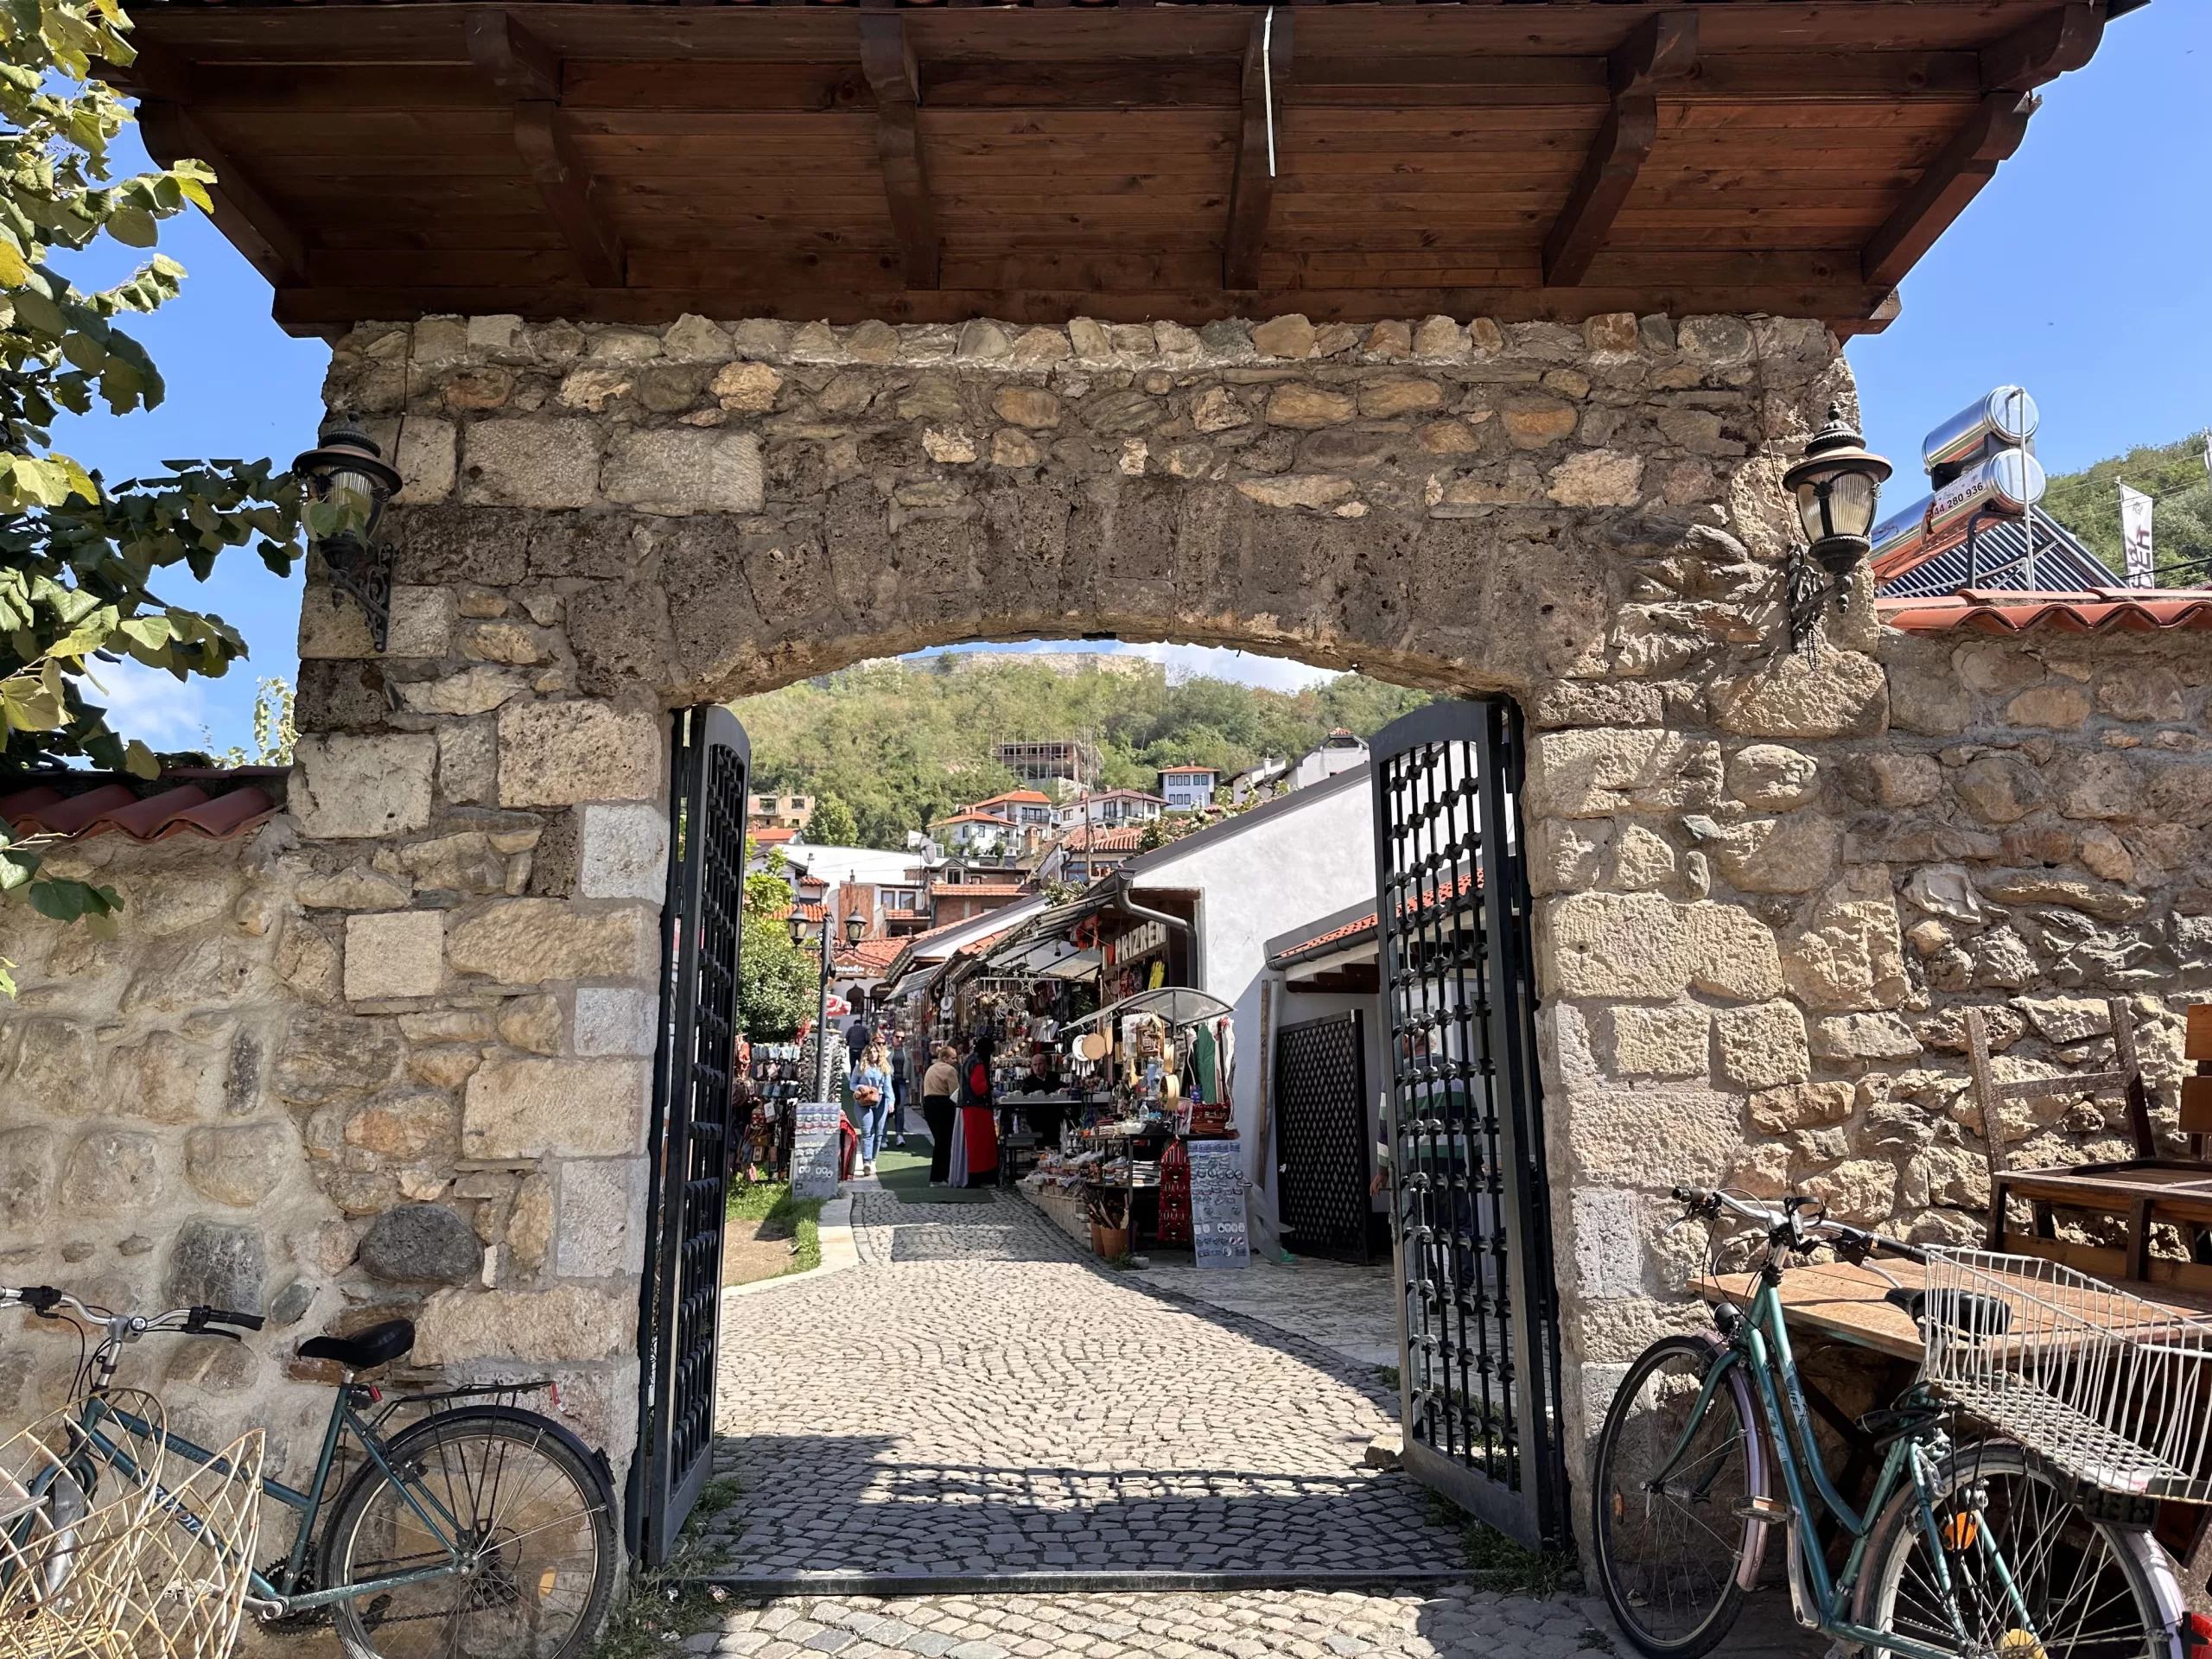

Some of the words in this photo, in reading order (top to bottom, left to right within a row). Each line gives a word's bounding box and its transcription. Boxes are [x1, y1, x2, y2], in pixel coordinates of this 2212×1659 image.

[1947, 493, 1964, 509] 280
[1966, 482, 1983, 498] 936
[1115, 920, 1166, 965] PRIZREN
[1788, 1384, 1801, 1413] LIFE
